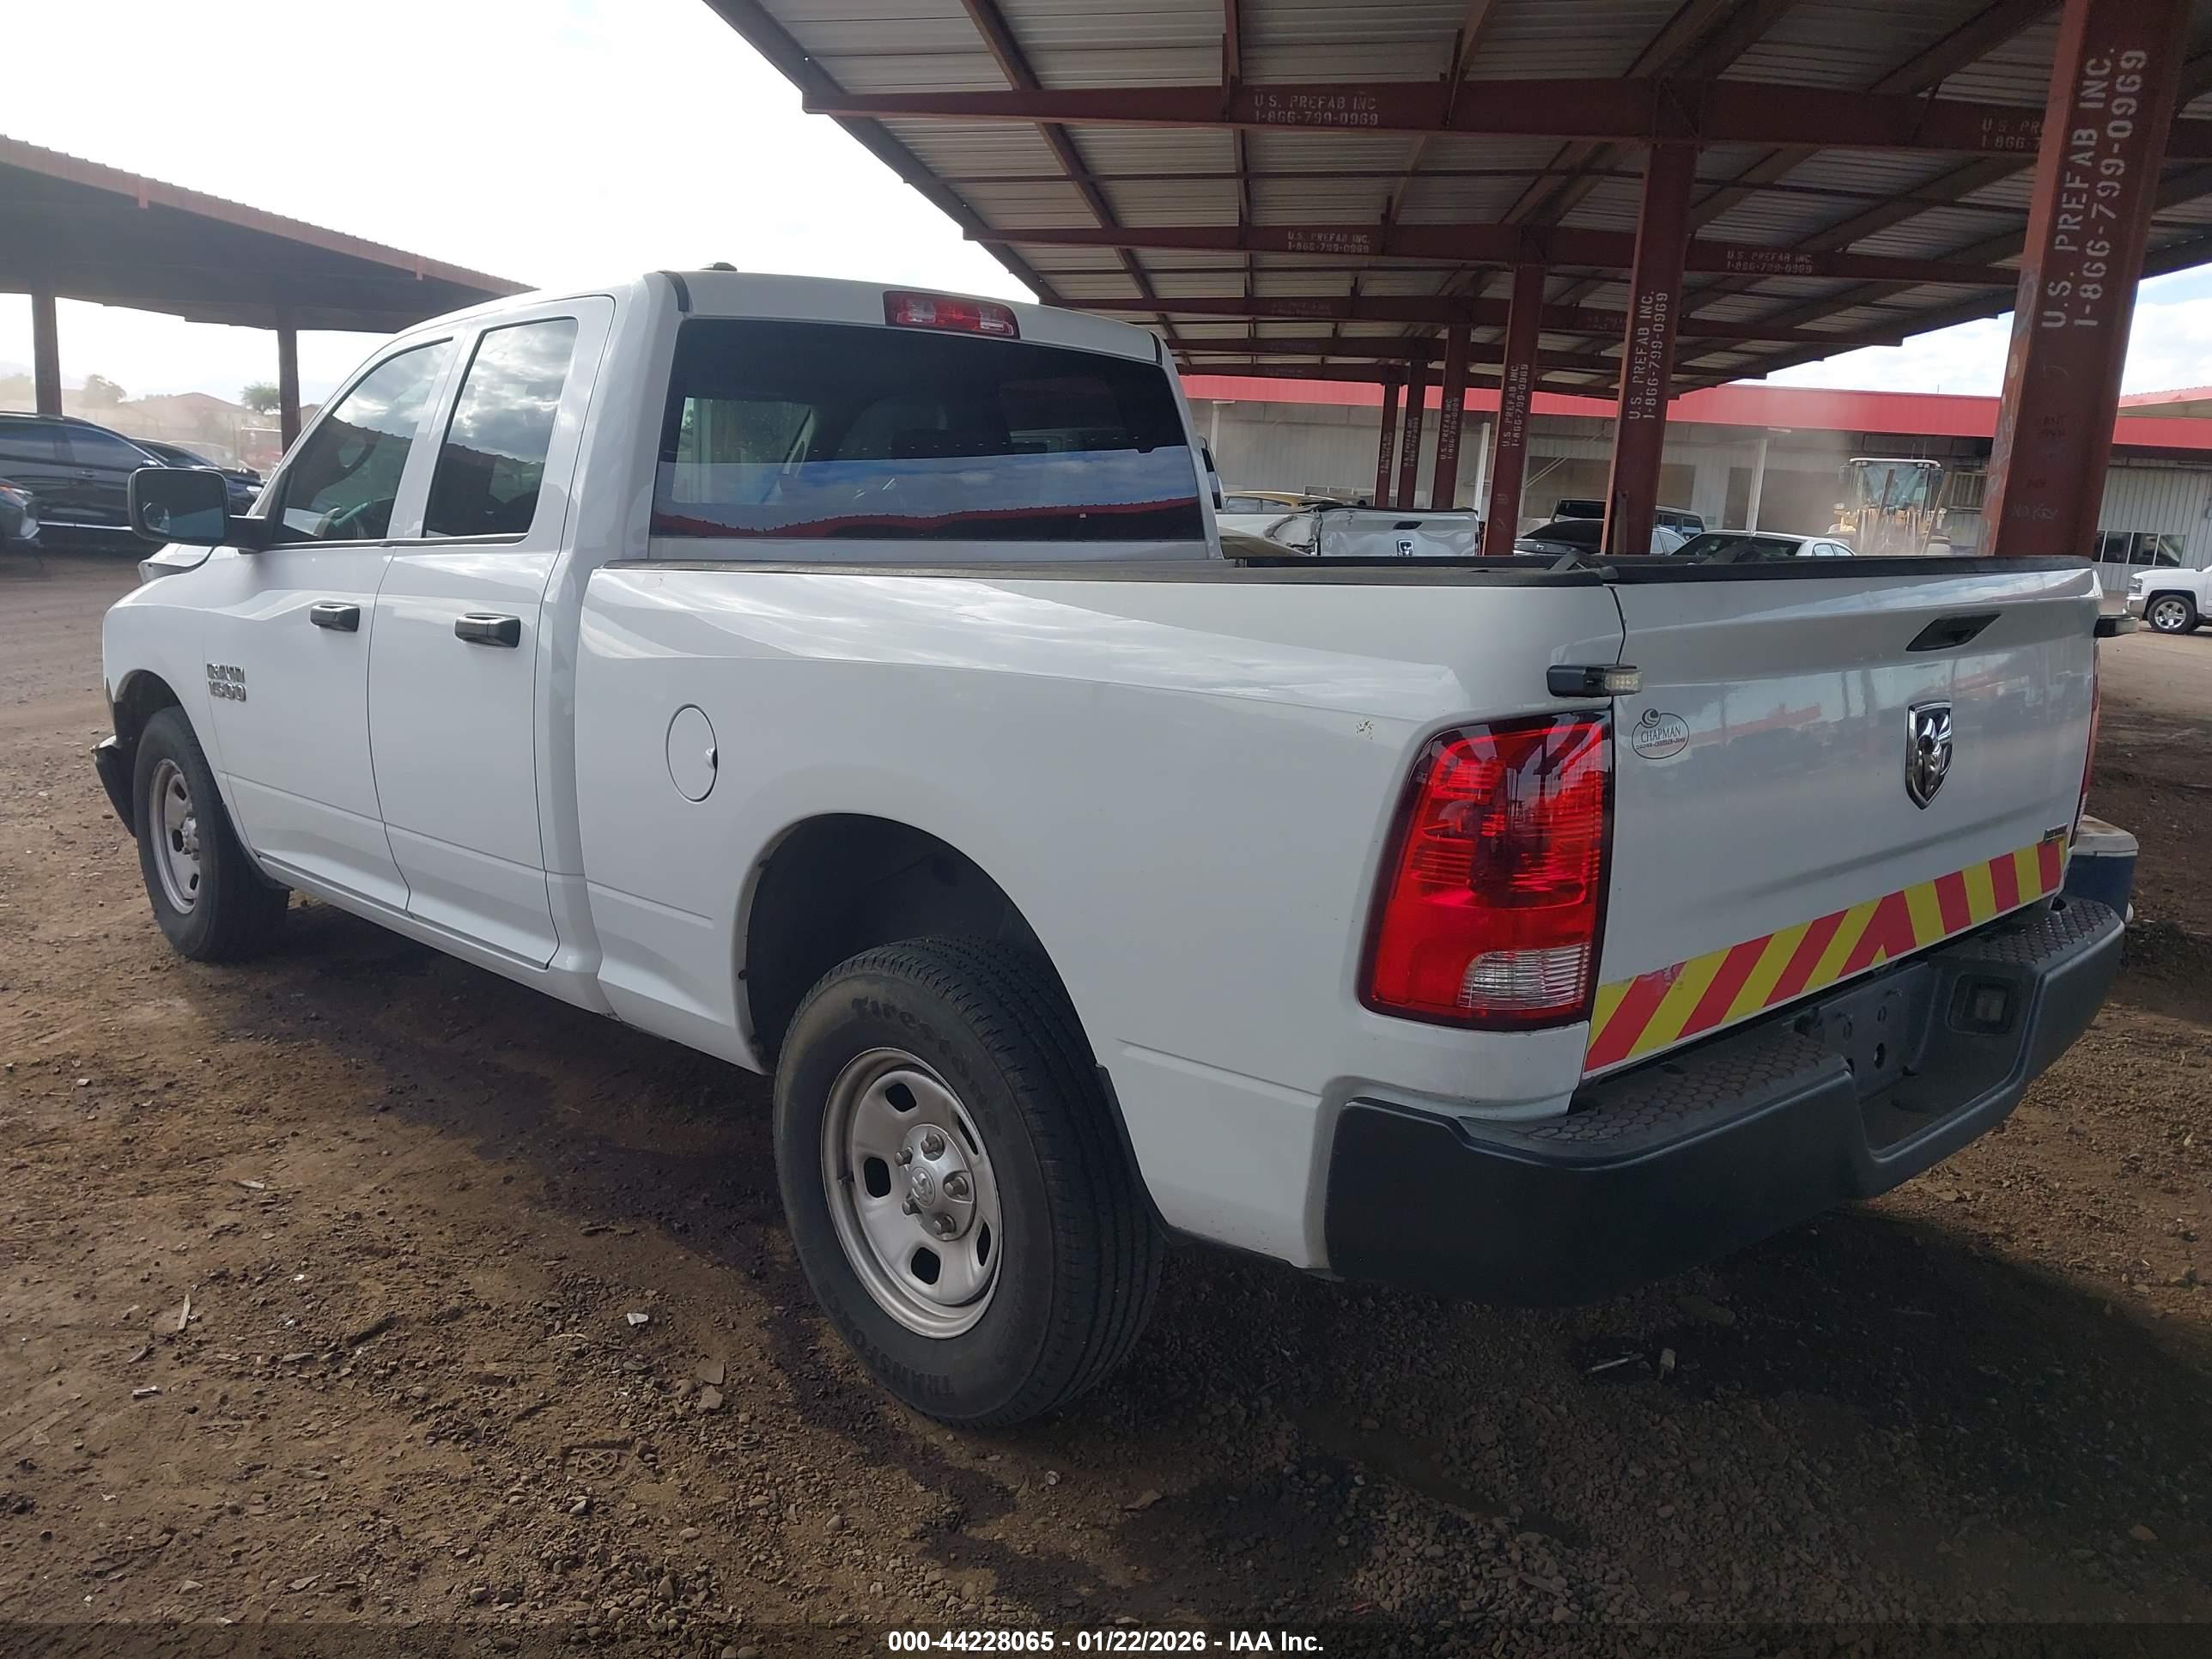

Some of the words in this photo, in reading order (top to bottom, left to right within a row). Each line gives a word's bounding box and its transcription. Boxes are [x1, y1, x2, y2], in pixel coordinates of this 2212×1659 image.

[2079, 47, 2116, 109] INC.
[1255, 111, 1379, 126] 1-866-799-0969
[1290, 94, 1346, 110] PREFAB
[2054, 126, 2098, 252] PREFAB
[2074, 49, 2147, 327] 1-866-799-0969
[1639, 290, 1655, 319] INC.
[2041, 271, 2075, 328] U.S.
[1632, 326, 1650, 384] PREFAB
[1643, 292, 1668, 419] 1-866-799-0969
[1504, 386, 1517, 425] PREFAB
[1628, 392, 1644, 420] U.S.
[208, 680, 246, 702] 1500
[1640, 725, 1681, 743] CHAPMAN
